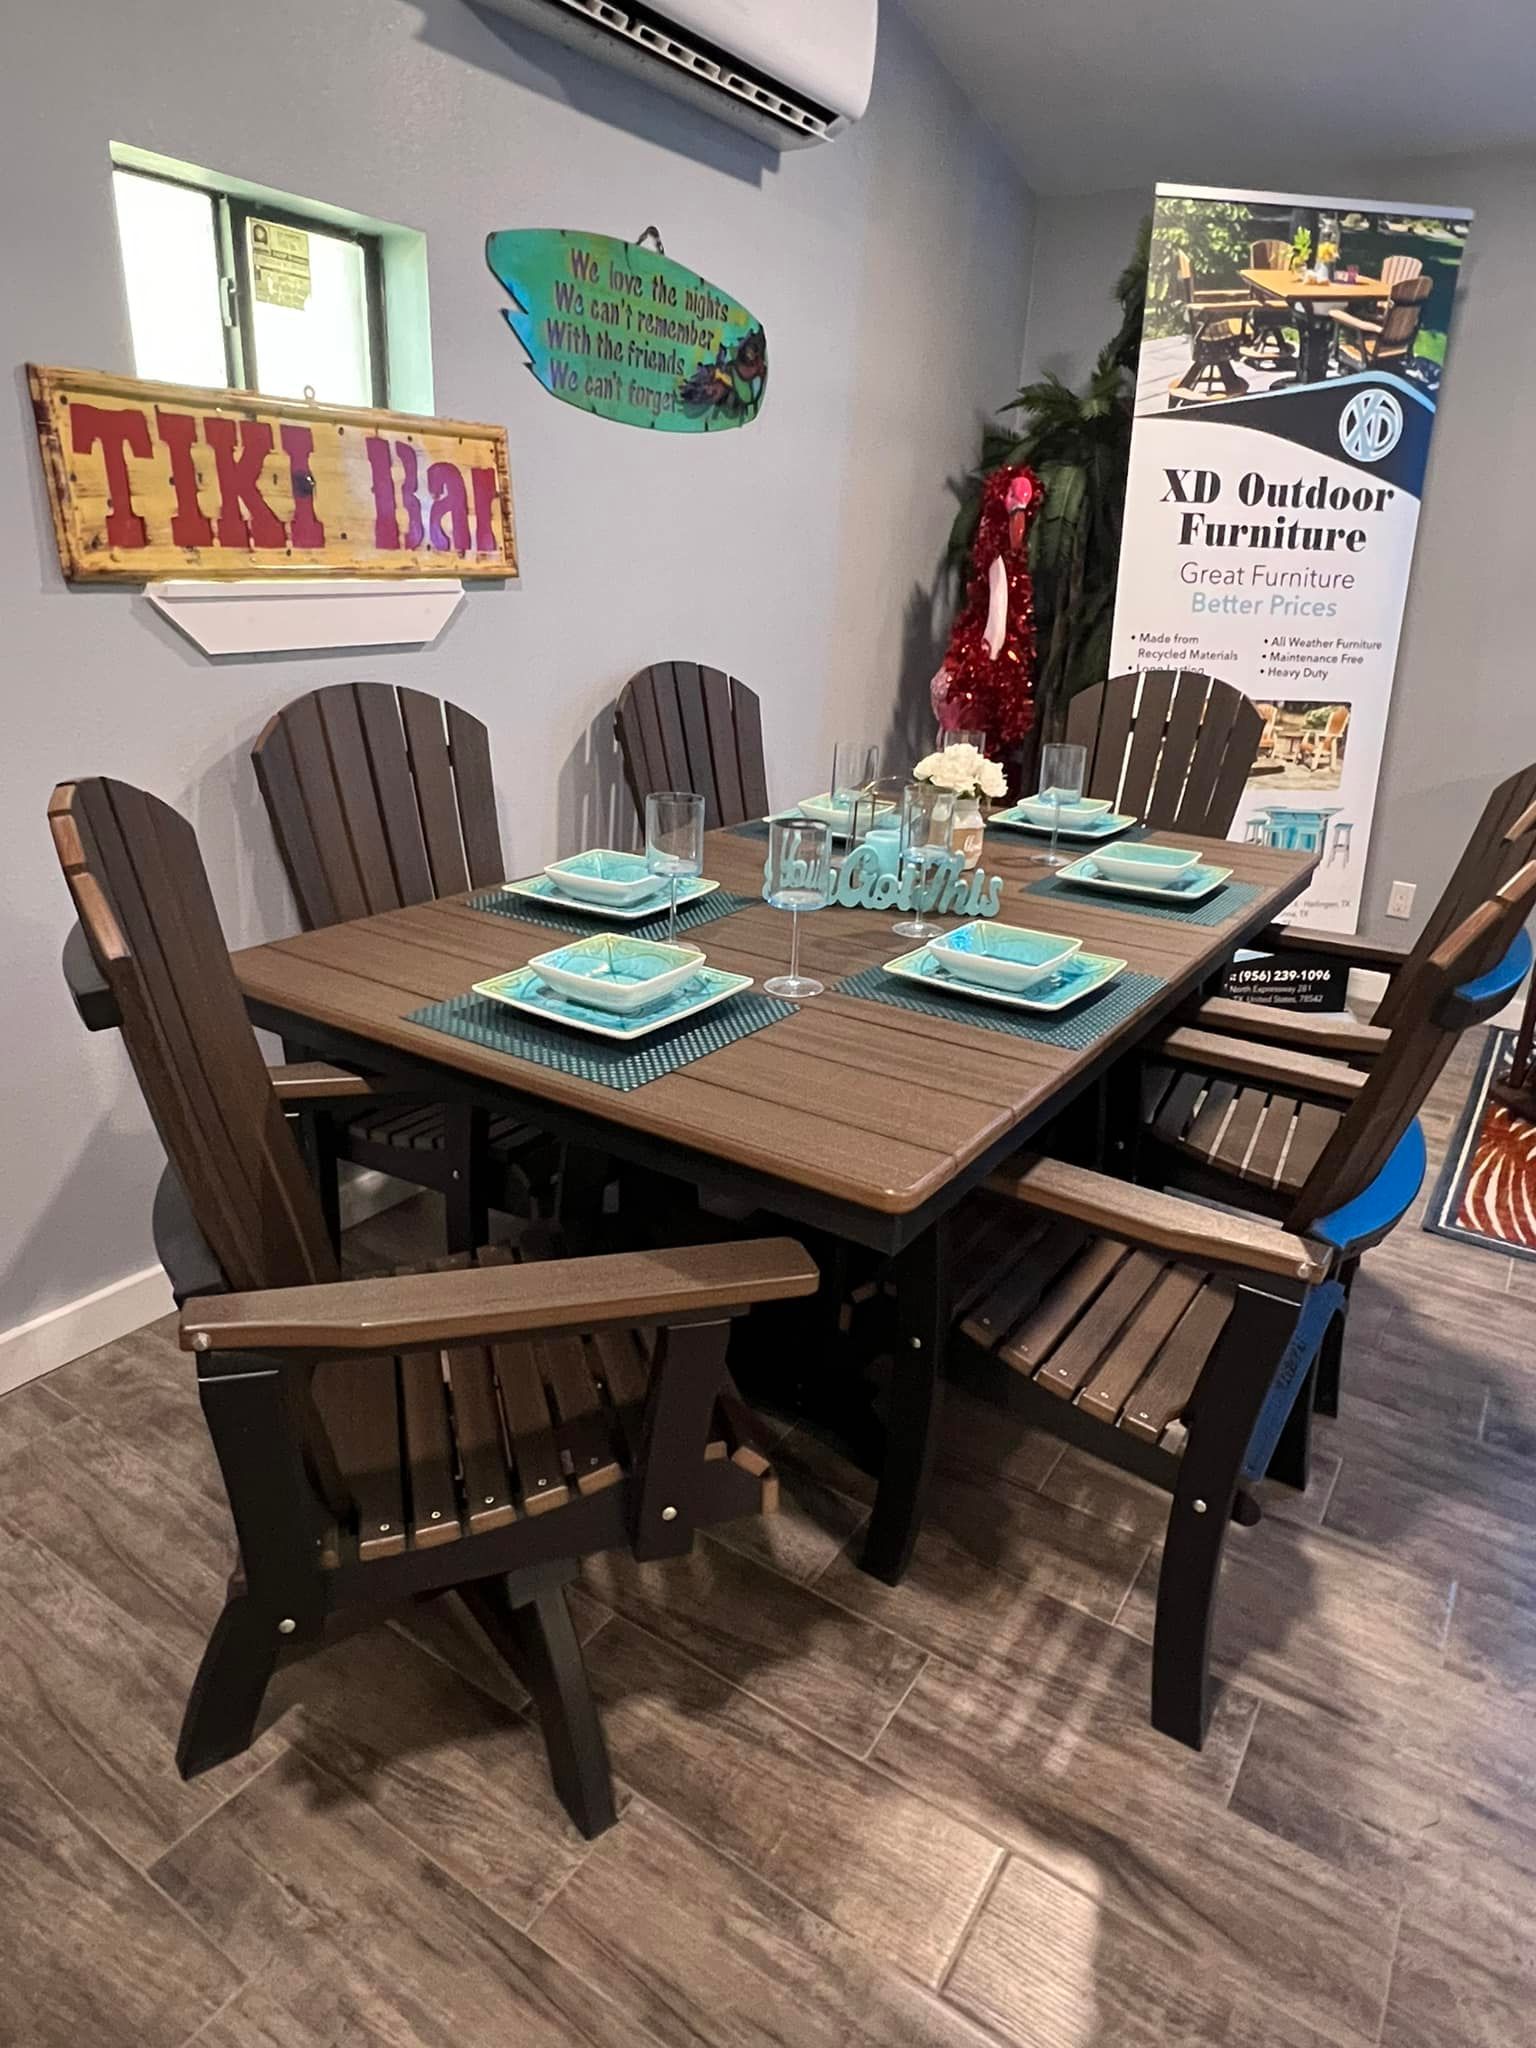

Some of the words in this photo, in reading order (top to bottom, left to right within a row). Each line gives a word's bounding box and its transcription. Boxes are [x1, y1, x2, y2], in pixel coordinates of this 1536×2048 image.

[571, 248, 600, 281] We
[609, 260, 643, 297] love
[652, 275, 677, 307] the
[685, 287, 729, 322] nights
[555, 280, 584, 314] We
[591, 297, 632, 330] can't
[637, 312, 714, 350] remember
[547, 318, 591, 355] With
[597, 330, 623, 362] the
[628, 342, 685, 375] friends
[551, 360, 578, 391] We
[585, 371, 622, 400] can't
[69, 402, 325, 549] TIKI
[365, 436, 497, 551] Bar
[1159, 468, 1221, 503] XD
[1237, 471, 1395, 512] Outdoor
[1178, 511, 1367, 553] Furniture
[1180, 561, 1245, 585] Great
[1251, 564, 1355, 589] Furniture
[1192, 592, 1263, 615] Better
[1270, 594, 1337, 617] Prices
[1139, 633, 1171, 644] Made
[1174, 633, 1199, 645] from
[1271, 637, 1286, 647] All
[1289, 637, 1334, 648] Weather
[1336, 638, 1382, 650] Furniture
[1138, 648, 1186, 661] Recycled
[1189, 650, 1238, 660] Materials
[1269, 652, 1338, 664] Maintenance
[1341, 654, 1364, 664] Free
[1268, 667, 1300, 680] Heavy
[1303, 668, 1328, 680] Duty
[1239, 970, 1271, 983] (956)
[1273, 970, 1331, 981] 239-1096
